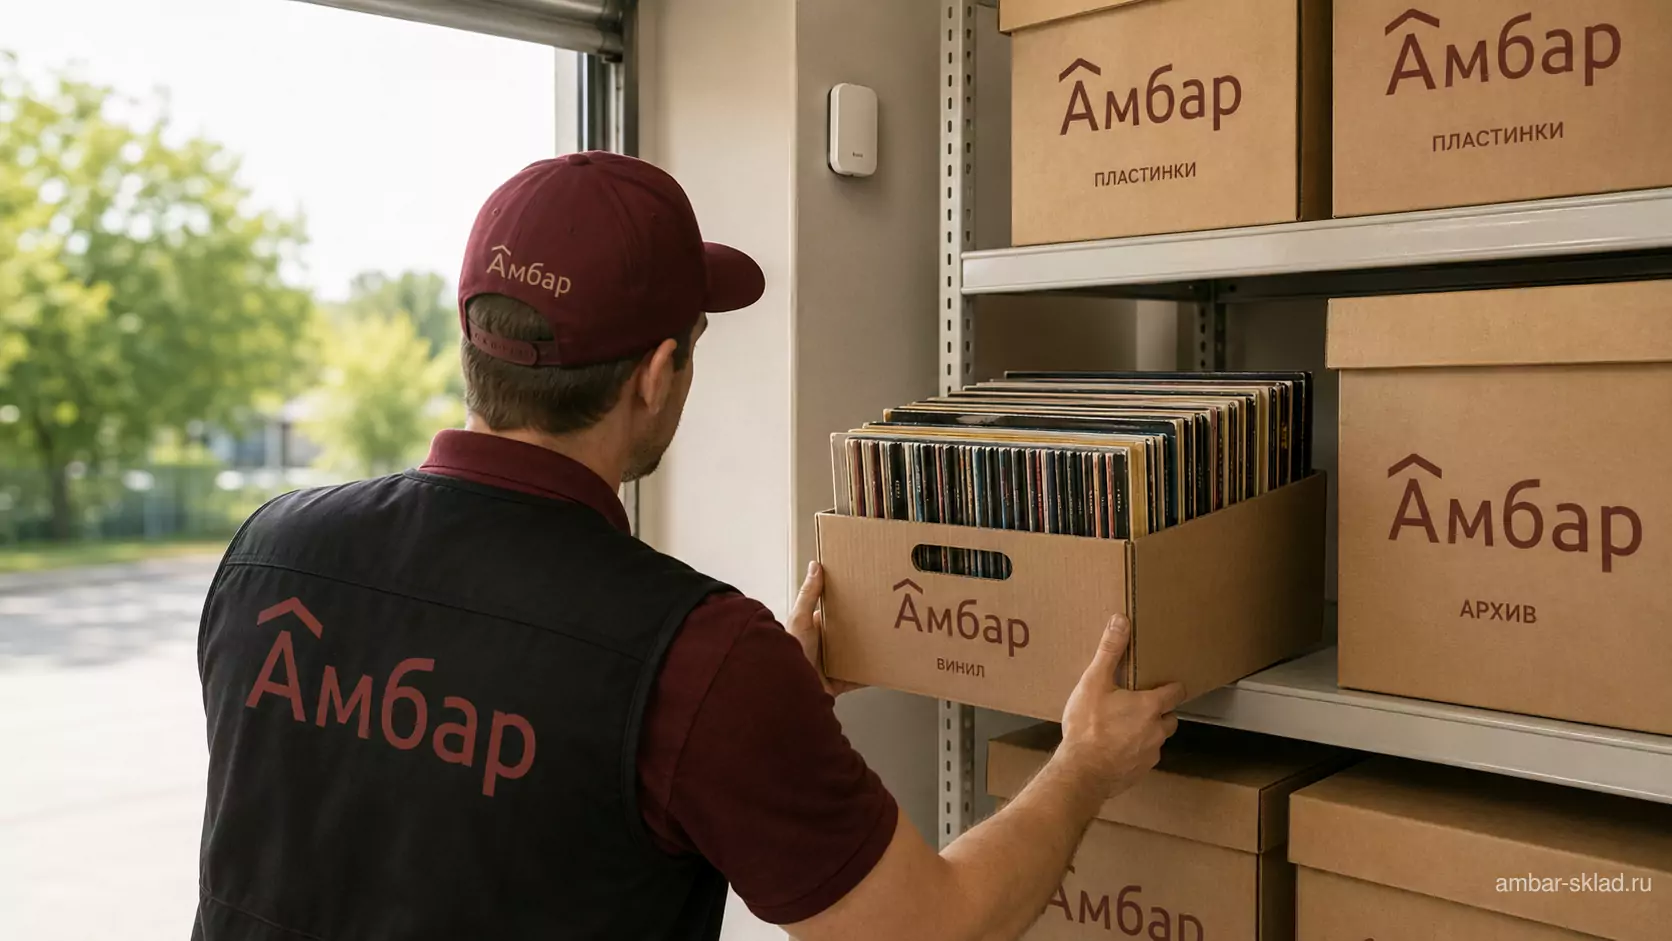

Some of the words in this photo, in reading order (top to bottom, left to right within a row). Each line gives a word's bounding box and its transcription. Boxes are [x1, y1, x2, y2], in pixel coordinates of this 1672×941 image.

[1385, 10, 1622, 96] Амбар
[1058, 61, 1242, 136] Амбар
[1432, 121, 1564, 152] ПЛАСТИНКИ
[1094, 161, 1197, 188] ПЛАСТИНКИ
[485, 252, 572, 298] Амбар
[1387, 477, 1643, 573] Амбар
[893, 592, 1030, 657] Амбар
[1459, 599, 1537, 624] АРХИВ
[245, 630, 537, 797] Амбар
